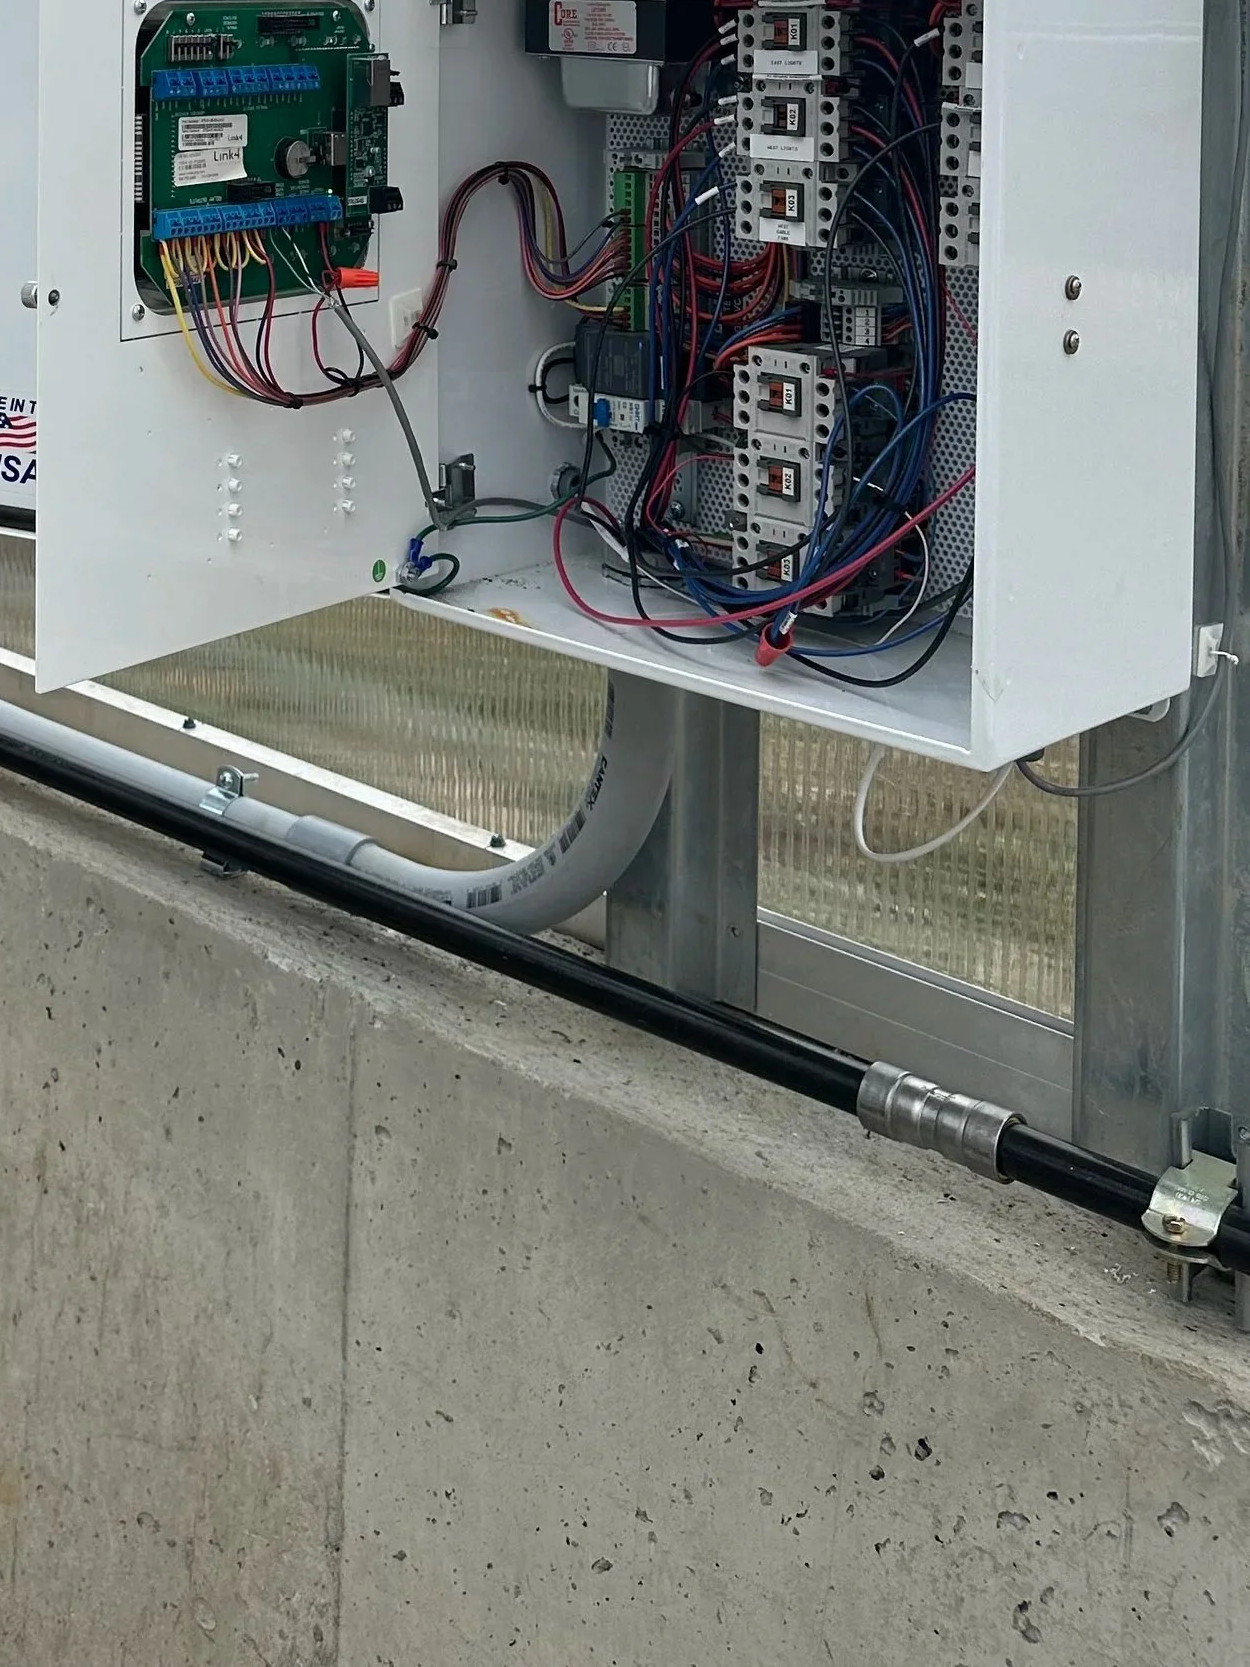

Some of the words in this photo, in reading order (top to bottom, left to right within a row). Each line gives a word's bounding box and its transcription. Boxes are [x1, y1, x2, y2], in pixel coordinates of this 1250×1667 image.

[554, 1, 578, 26] CORE
[790, 23, 798, 40] K01
[788, 109, 797, 125] K02
[213, 148, 240, 162] Link4
[788, 195, 796, 211] K03
[785, 388, 793, 404] K01
[10, 398, 25, 413] IN
[784, 473, 792, 490] K02
[783, 559, 791, 576] K03
